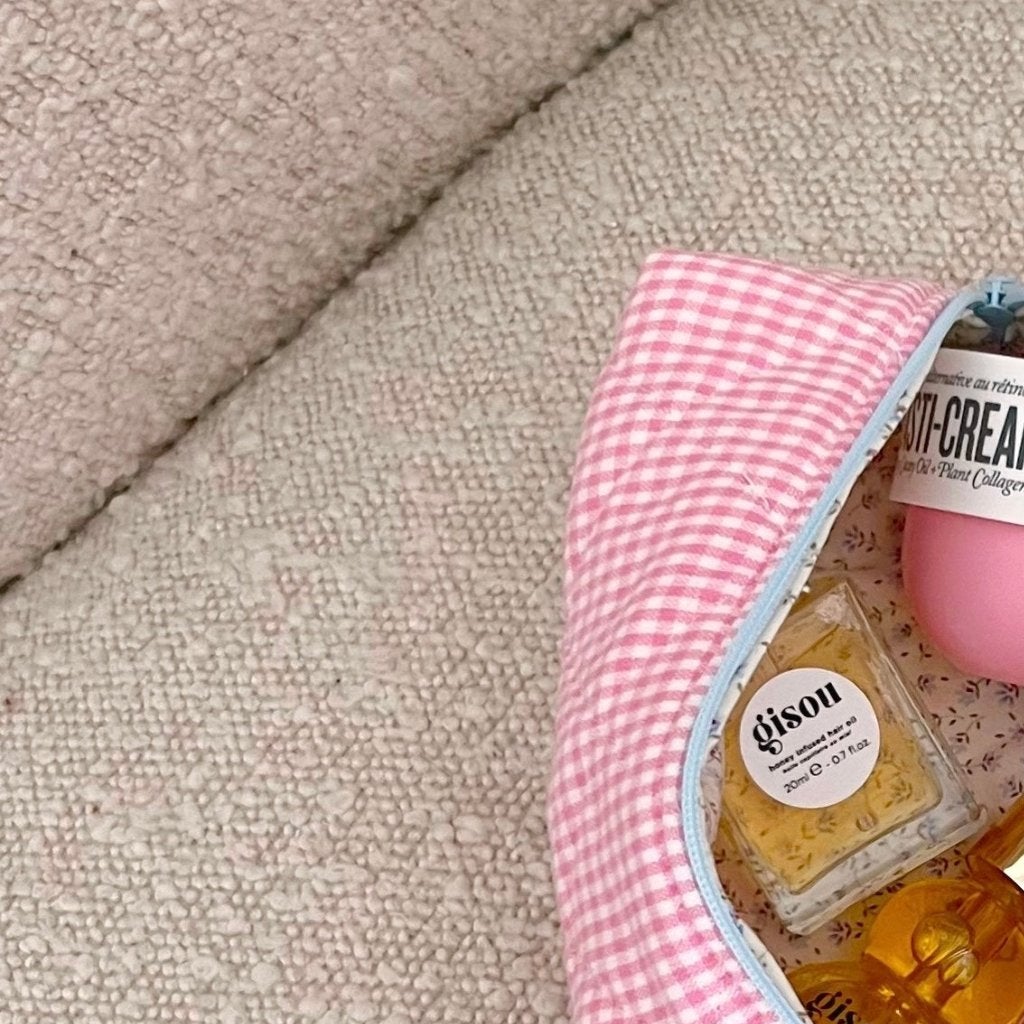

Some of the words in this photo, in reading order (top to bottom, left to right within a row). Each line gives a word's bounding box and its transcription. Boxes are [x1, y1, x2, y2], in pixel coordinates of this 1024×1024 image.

[973, 378, 989, 390] au
[937, 461, 971, 481] Plant
[752, 682, 842, 755] gisou
[768, 754, 794, 772] honey
[796, 734, 826, 756] infused
[828, 724, 844, 737] hair
[784, 773, 810, 793] 20ml
